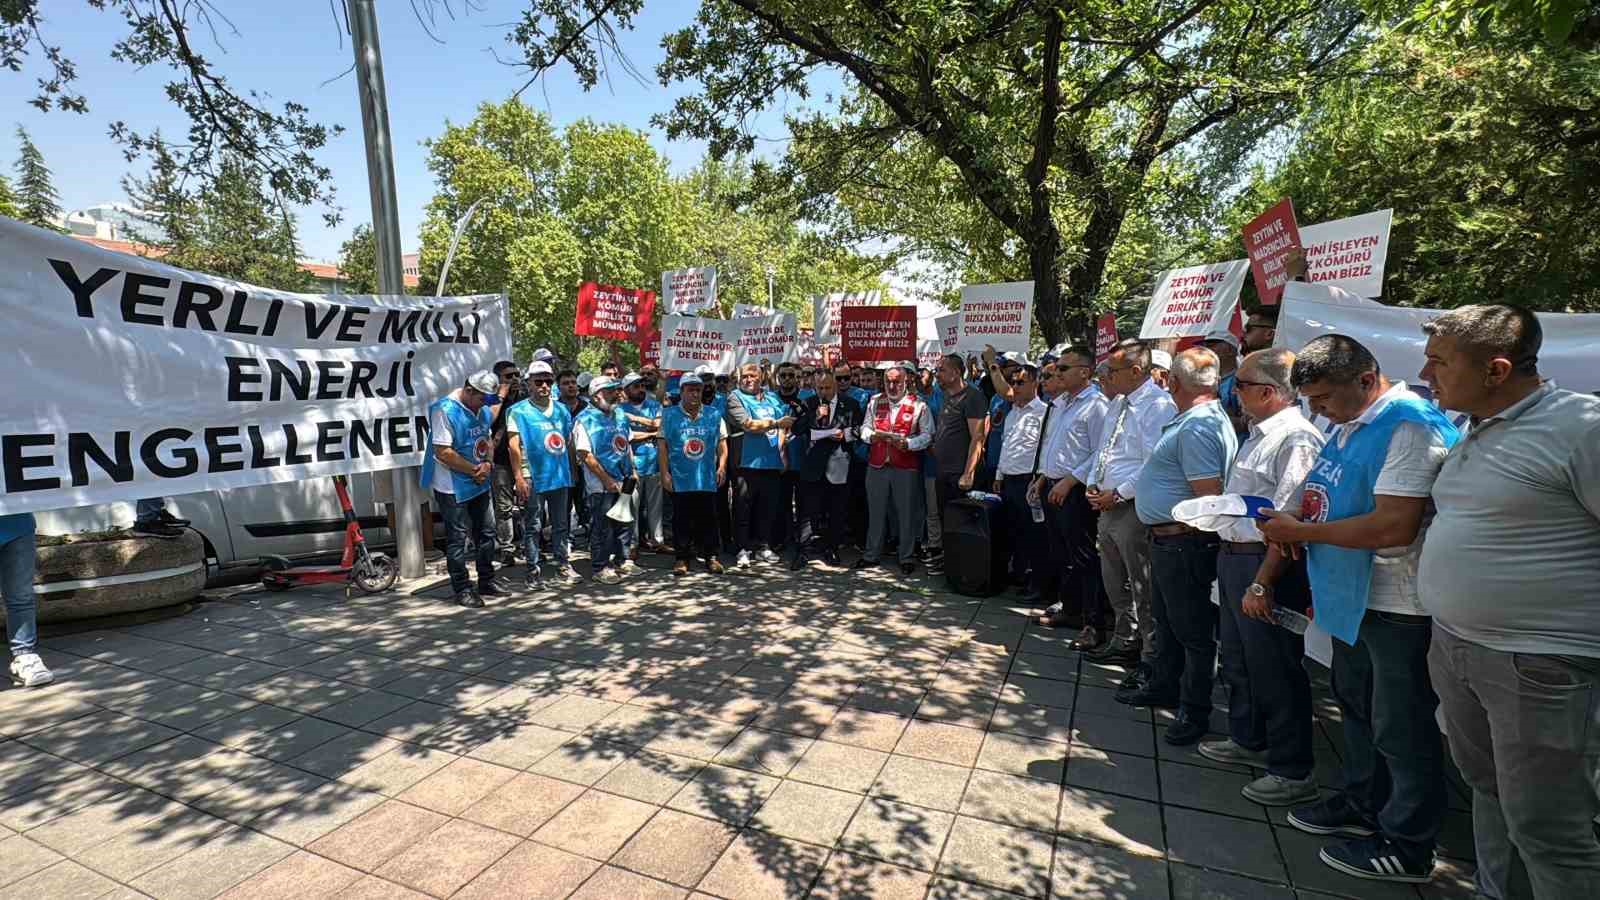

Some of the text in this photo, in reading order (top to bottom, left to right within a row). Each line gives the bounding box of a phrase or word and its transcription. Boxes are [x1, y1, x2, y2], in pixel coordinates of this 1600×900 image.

[1328, 236, 1379, 255] İŞLEYEN
[1315, 248, 1371, 269] KÖMÜRÜ
[1340, 264, 1372, 279] BİZİZ
[1171, 272, 1225, 287] ZEYTİN VE
[593, 290, 639, 304] ZEYTİN VE
[1172, 285, 1214, 300] KÖMÜR
[597, 300, 633, 312] KÖMÜR
[964, 300, 1025, 312] ZEYTİNİ İŞLEYEN
[1167, 300, 1214, 313] BİRLİKTE
[303, 301, 370, 341] VE
[378, 303, 480, 344] MİLLİ
[965, 311, 1022, 322] BİZİZ KÖMÜRÜ
[1161, 312, 1212, 326] MÜMKÜN
[592, 319, 637, 332] MÜMKÜN
[744, 325, 784, 336] ZEYTİN DE
[846, 320, 876, 329] ZEYTİNİ
[877, 320, 911, 330] İŞLEYEN
[964, 325, 1000, 336] ÇIKARAN
[1001, 324, 1023, 334] BİZİZ
[675, 328, 724, 340] ZEYTİN DE
[848, 329, 869, 338] BİZİZ
[870, 329, 908, 338] KÖMÜRÜ
[667, 337, 694, 349] BİZİM
[696, 341, 733, 352] KÖMÜR
[848, 339, 909, 349] ÇIKARAN BİZİZ
[679, 350, 720, 361] DE BİZİM
[225, 350, 416, 402] ENERJİ
